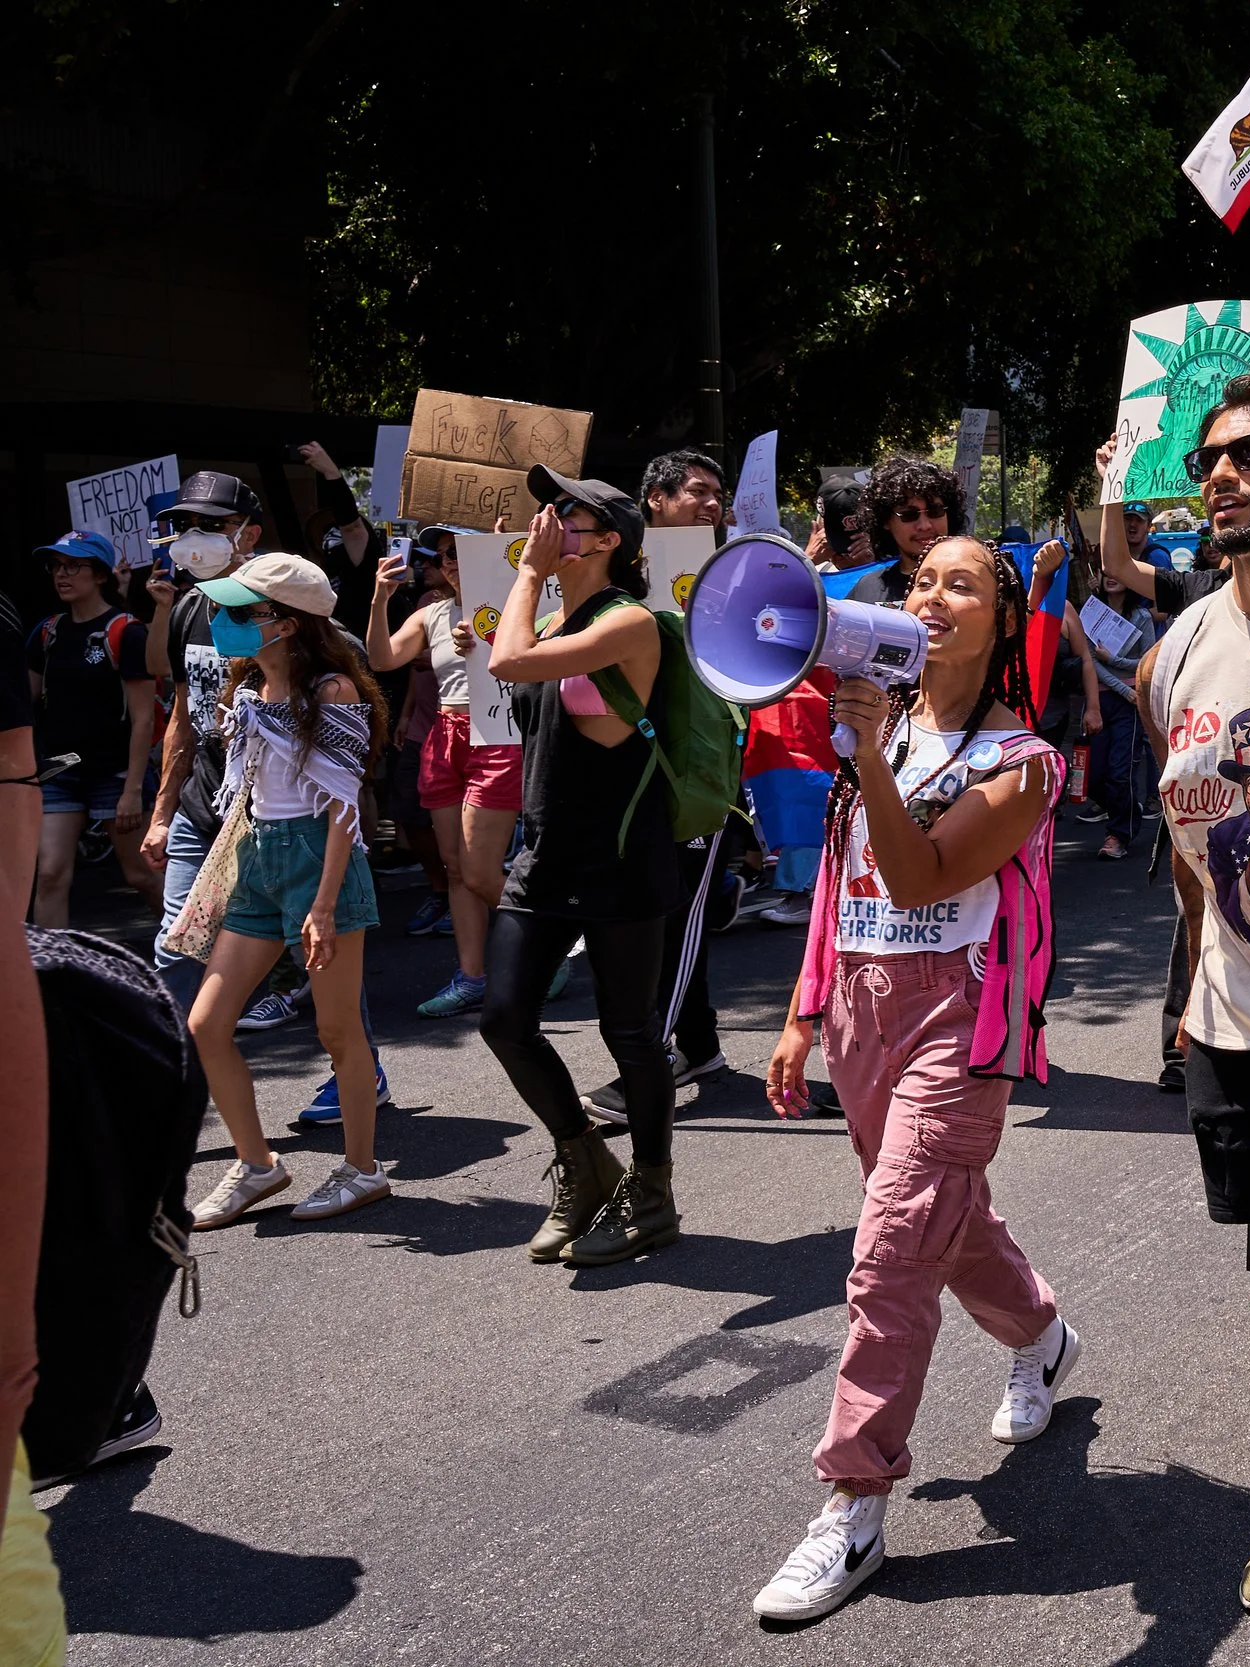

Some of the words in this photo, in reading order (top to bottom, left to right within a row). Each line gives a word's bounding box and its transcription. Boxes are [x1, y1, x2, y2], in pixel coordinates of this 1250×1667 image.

[78, 461, 166, 523] FREEDOM
[450, 474, 517, 521] ICE
[1108, 469, 1135, 501] You
[110, 508, 142, 536] NOT
